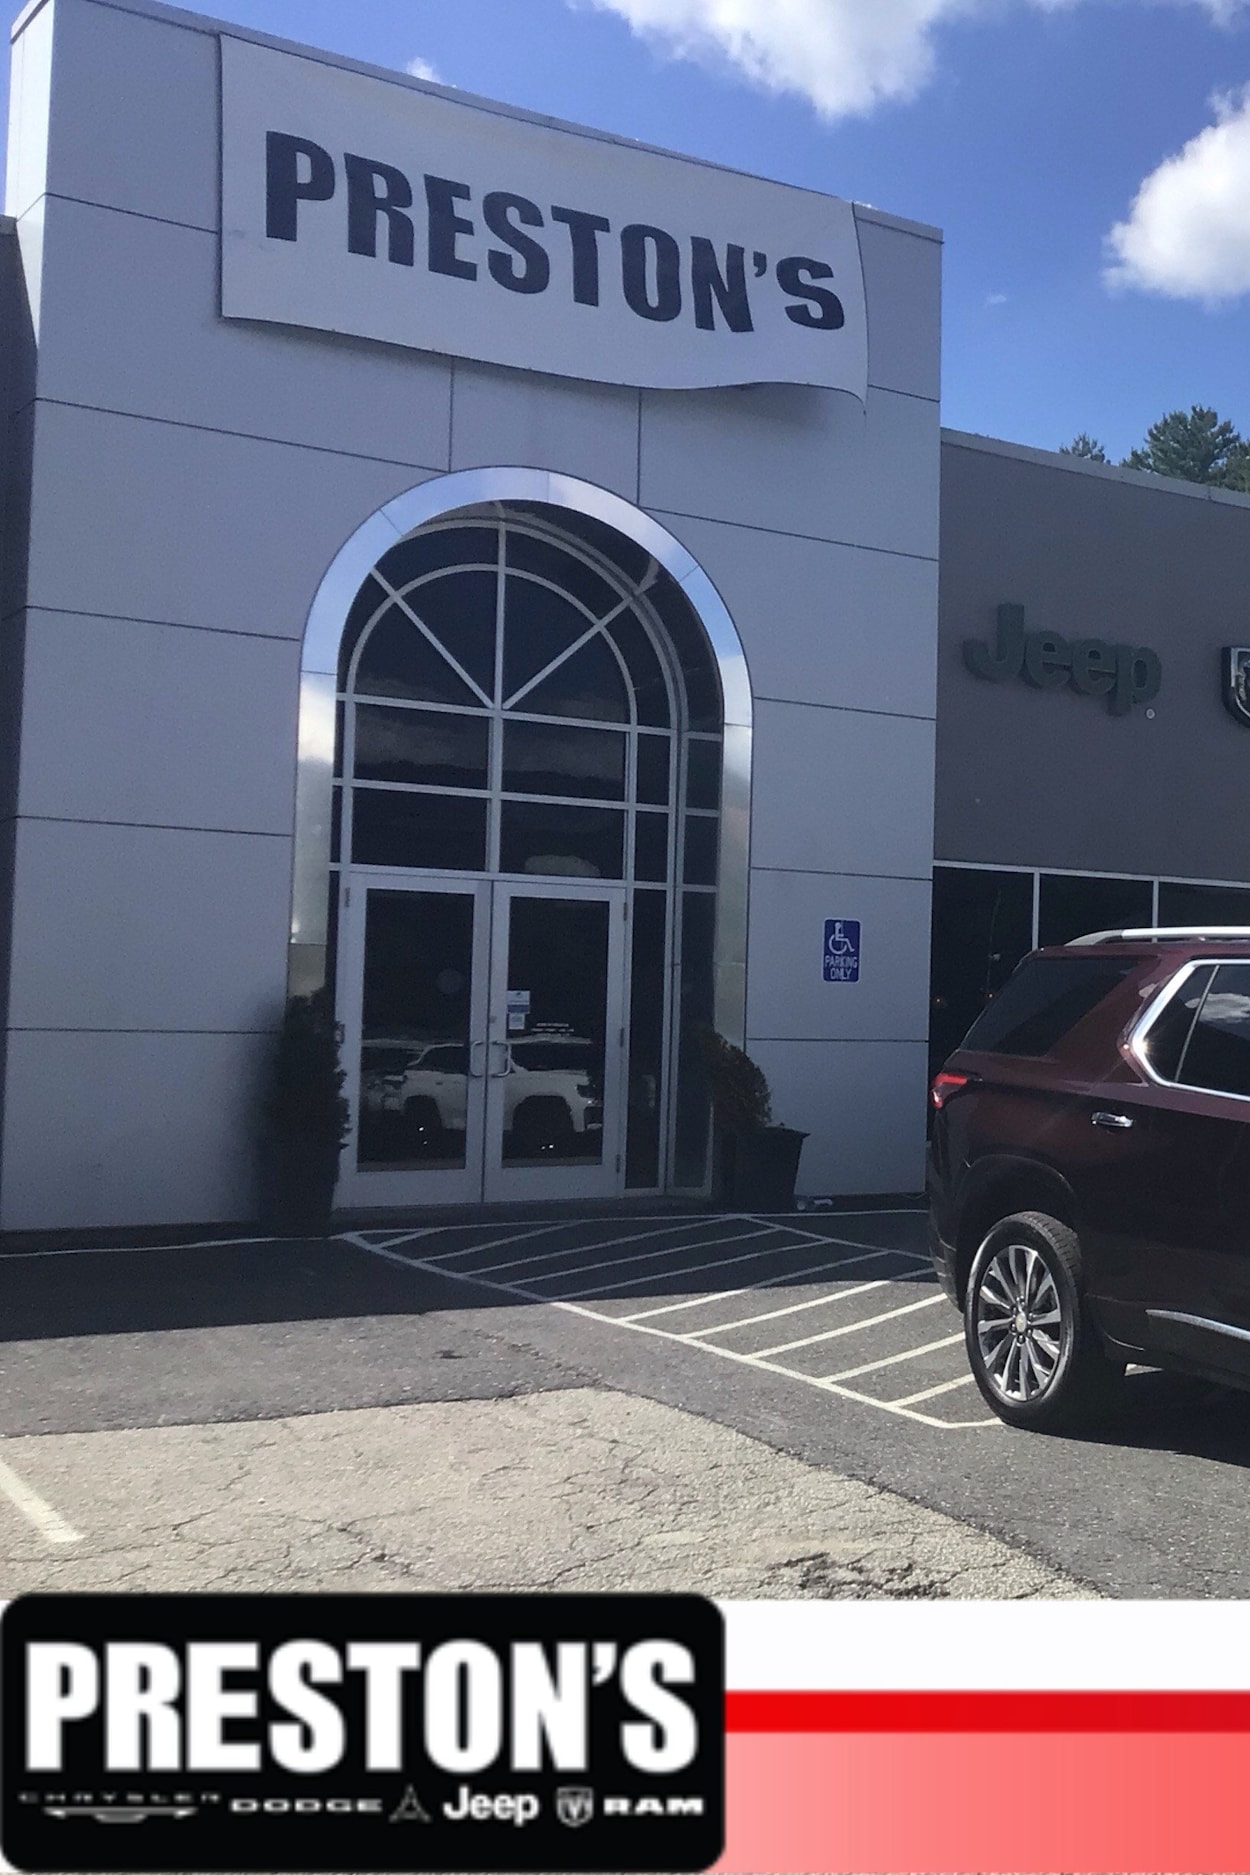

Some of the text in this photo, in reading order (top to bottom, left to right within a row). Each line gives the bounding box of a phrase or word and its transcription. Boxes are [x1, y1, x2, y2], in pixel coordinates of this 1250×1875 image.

[265, 130, 845, 333] PRESTON'S
[962, 603, 1163, 717] Jeep
[824, 955, 858, 968] PARKING
[830, 967, 853, 980] ONLY
